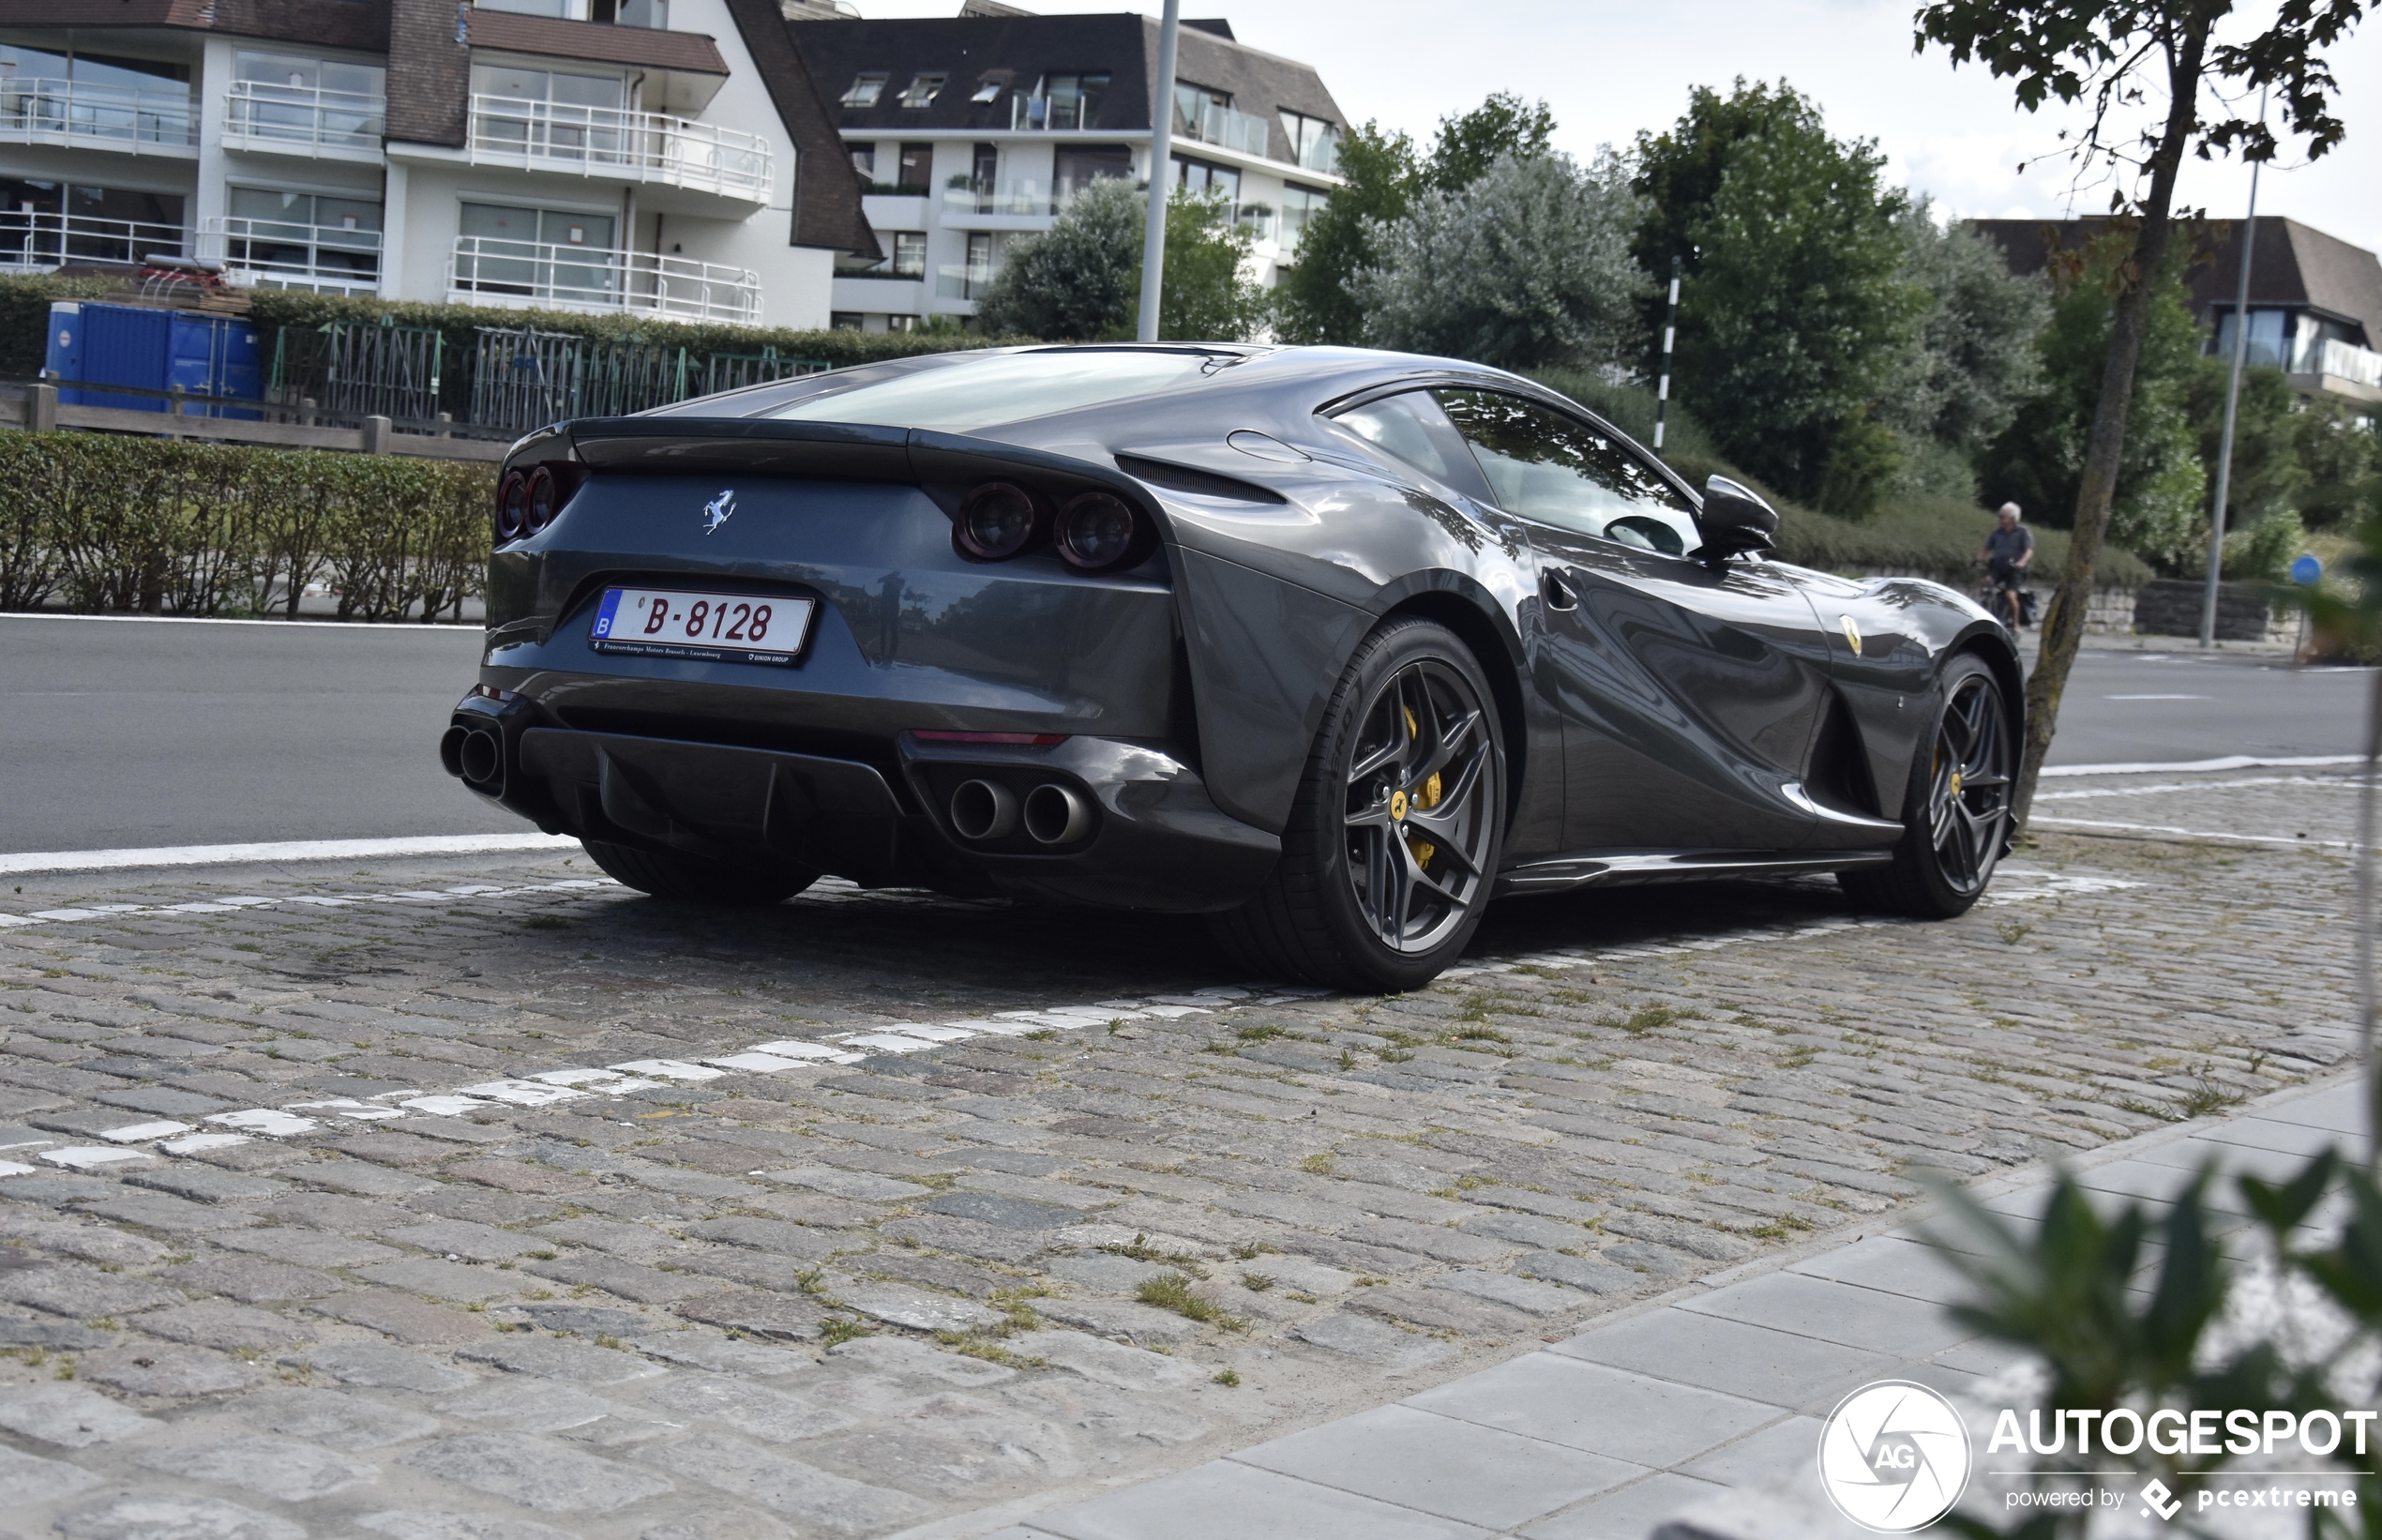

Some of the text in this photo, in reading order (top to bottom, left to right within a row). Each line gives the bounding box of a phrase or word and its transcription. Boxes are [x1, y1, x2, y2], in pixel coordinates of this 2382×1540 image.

[596, 618, 610, 635] B
[643, 598, 772, 642] B-8128
[1326, 705, 1353, 807] ZERO
